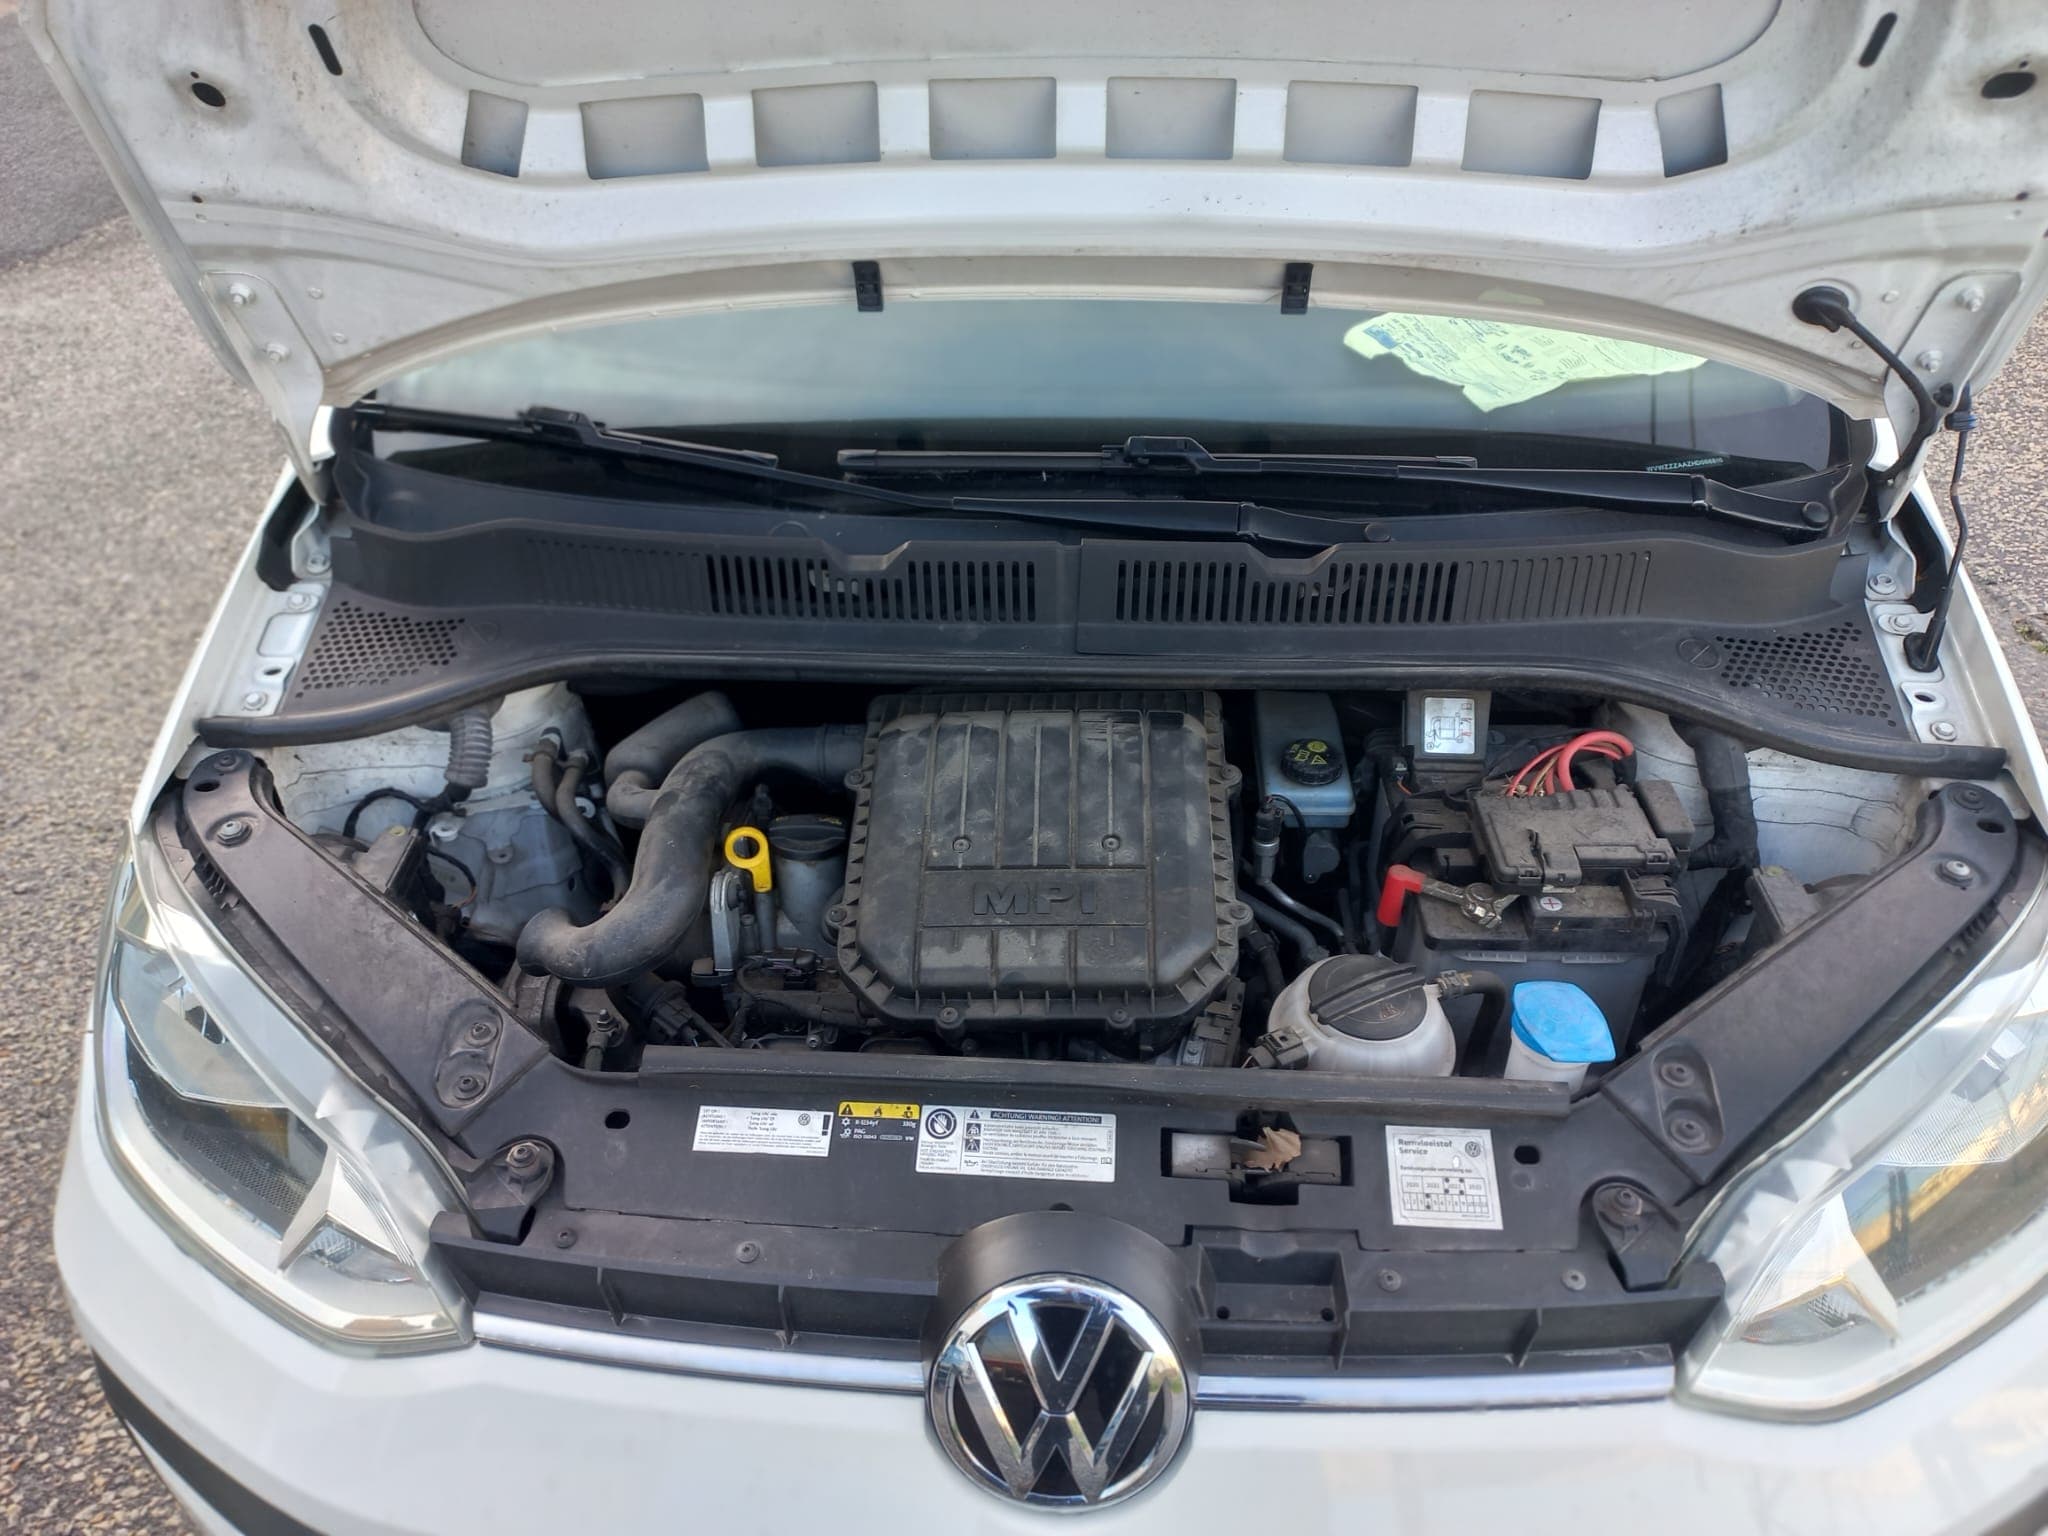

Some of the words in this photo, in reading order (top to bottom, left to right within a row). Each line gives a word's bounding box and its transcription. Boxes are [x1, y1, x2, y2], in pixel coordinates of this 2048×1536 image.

[973, 881, 1097, 915] MPI
[992, 1111, 1027, 1120] ACHTUNG!
[1027, 1113, 1062, 1122] WARNING!
[1062, 1115, 1101, 1123] ATTENTION!
[1399, 1147, 1428, 1155] Service
